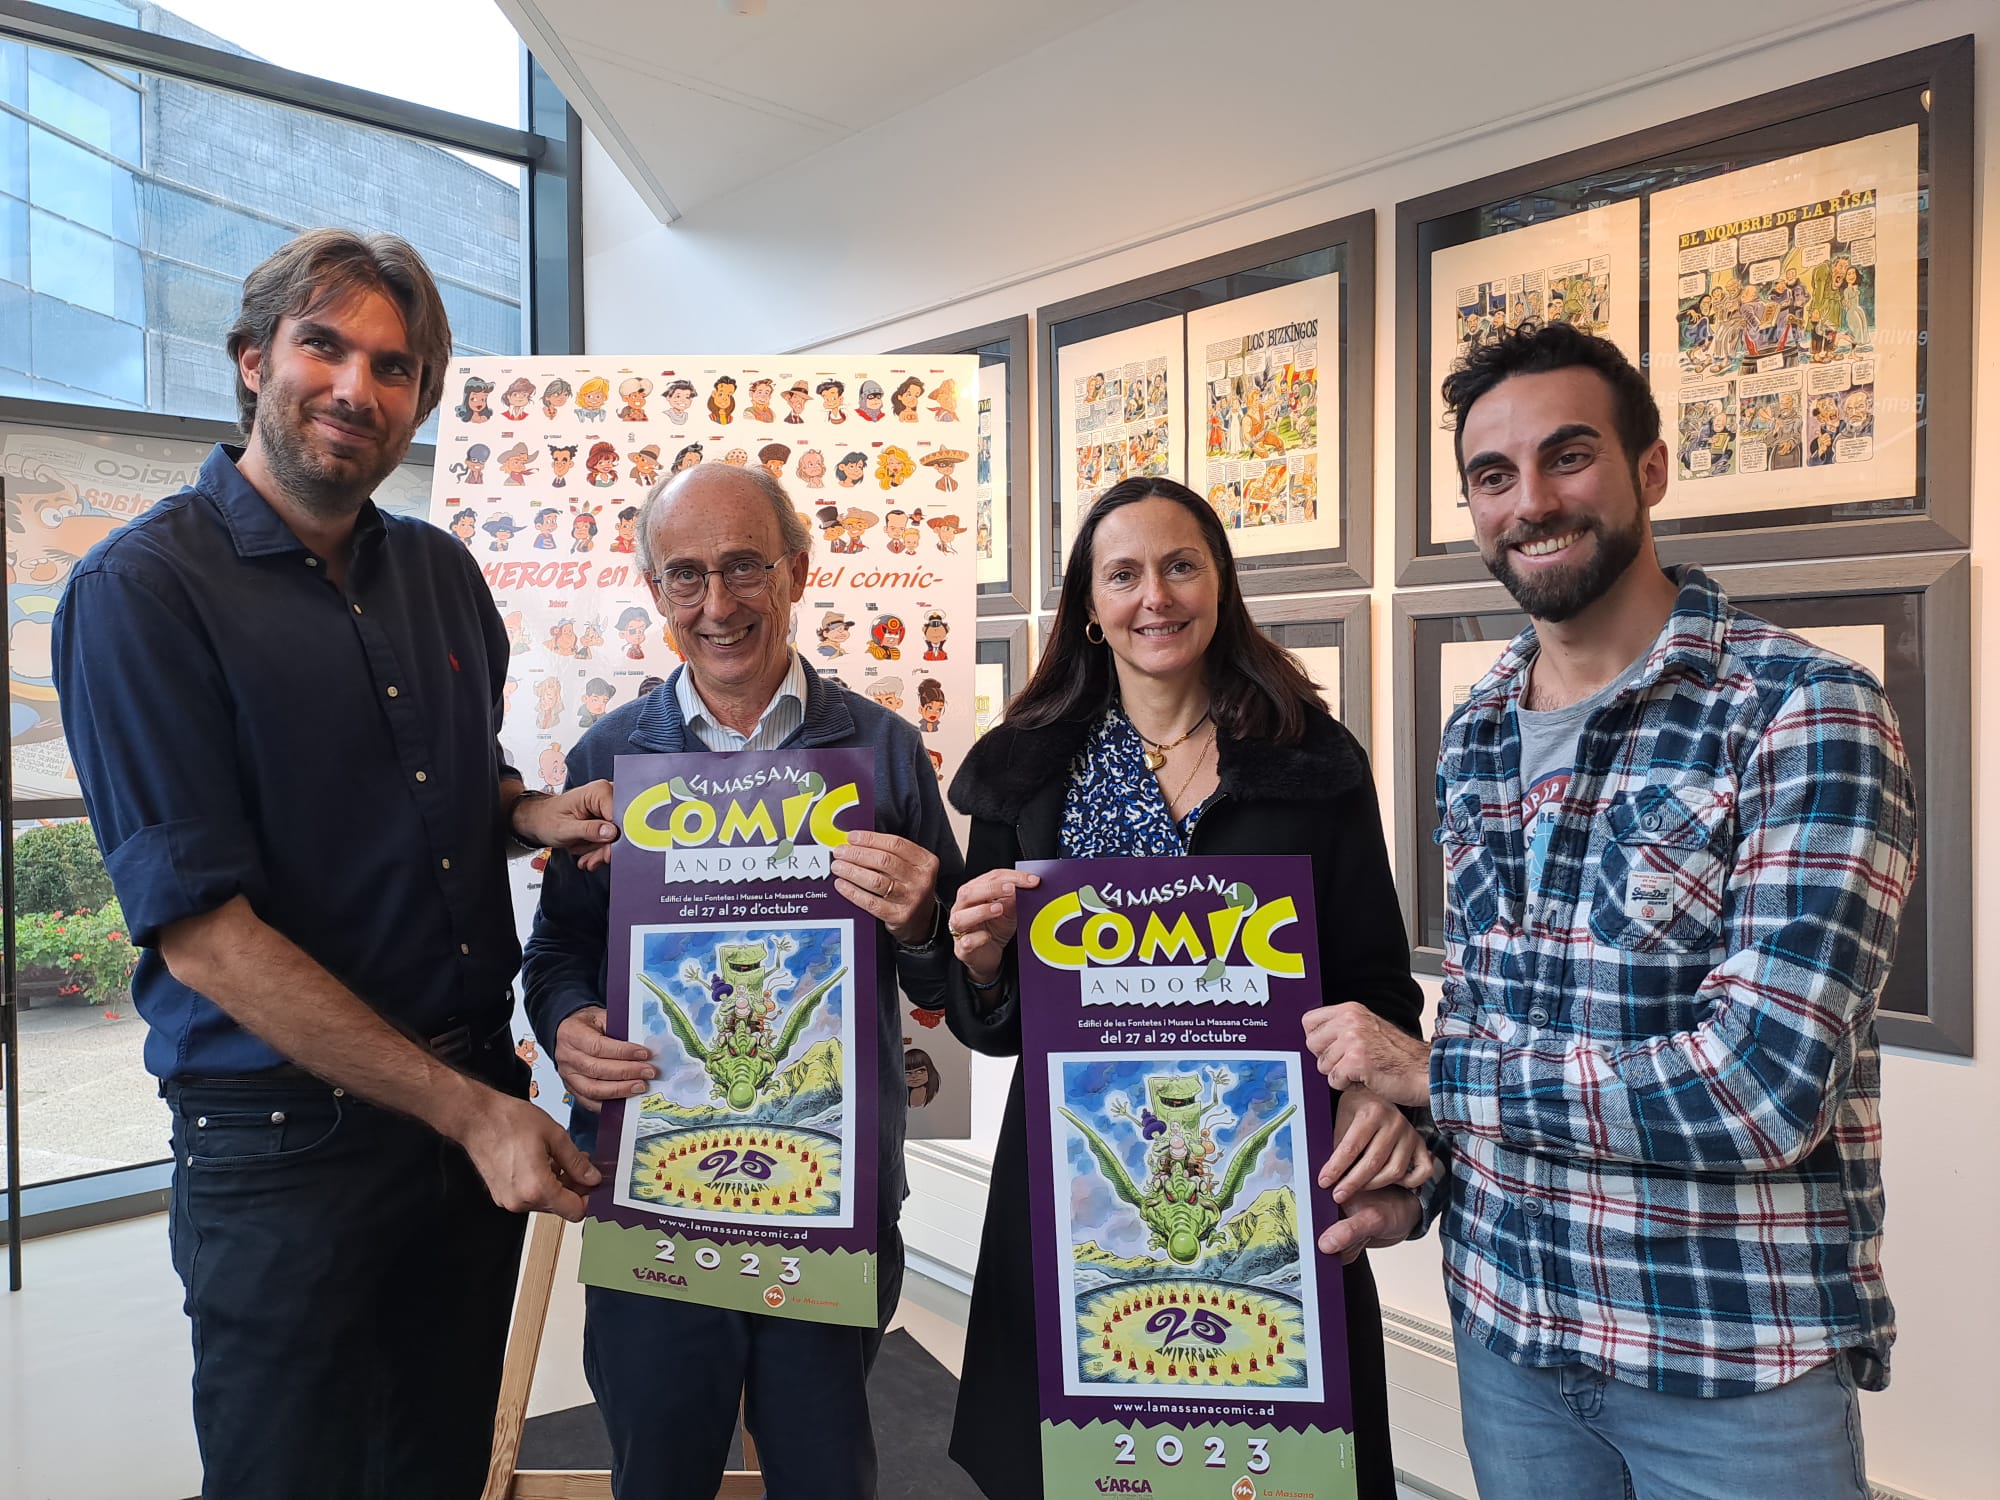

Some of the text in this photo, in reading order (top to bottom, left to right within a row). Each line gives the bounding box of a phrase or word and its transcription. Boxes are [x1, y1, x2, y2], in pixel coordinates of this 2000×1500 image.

[1679, 189, 1875, 248] EL NOMBRE DE LA RISA
[1246, 330, 1265, 352] LOS
[1268, 319, 1318, 344] BIZKINGOS
[484, 561, 629, 590] HEROES en
[806, 566, 846, 588] del
[688, 765, 811, 796] LA MASSANA
[674, 853, 822, 873] ANDORRA
[660, 895, 682, 903] Edifici
[683, 894, 692, 902] de
[693, 894, 703, 902] les
[764, 892, 773, 900] La
[805, 891, 828, 899] Còmic
[1100, 874, 1239, 908] LA MASSANA
[679, 902, 809, 917] del 27 al 29 d'octubre
[1091, 977, 1258, 995] ANDORRA
[1078, 1020, 1102, 1028] Edifici
[1103, 1019, 1114, 1027] de
[1115, 1019, 1127, 1027] les
[1127, 1018, 1162, 1027] Fontetes
[1167, 1019, 1194, 1027] Museu
[1195, 1018, 1206, 1026] La
[1206, 1018, 1241, 1026] Massana
[1242, 1018, 1268, 1027] Còmic
[1100, 1029, 1247, 1045] del 27 al 29 d'octubre
[697, 1149, 778, 1182] 25
[658, 1217, 809, 1241] www.lamassanacomic.ad
[655, 1239, 801, 1286] 2023
[632, 1267, 689, 1288] L'ARCA
[1145, 1307, 1232, 1346] 25
[1113, 1401, 1275, 1416] www.lamassanacomic.ad
[1114, 1434, 1271, 1476] 2023
[1094, 1476, 1153, 1494] L'ARCA
[1263, 1488, 1314, 1499] La Massana
